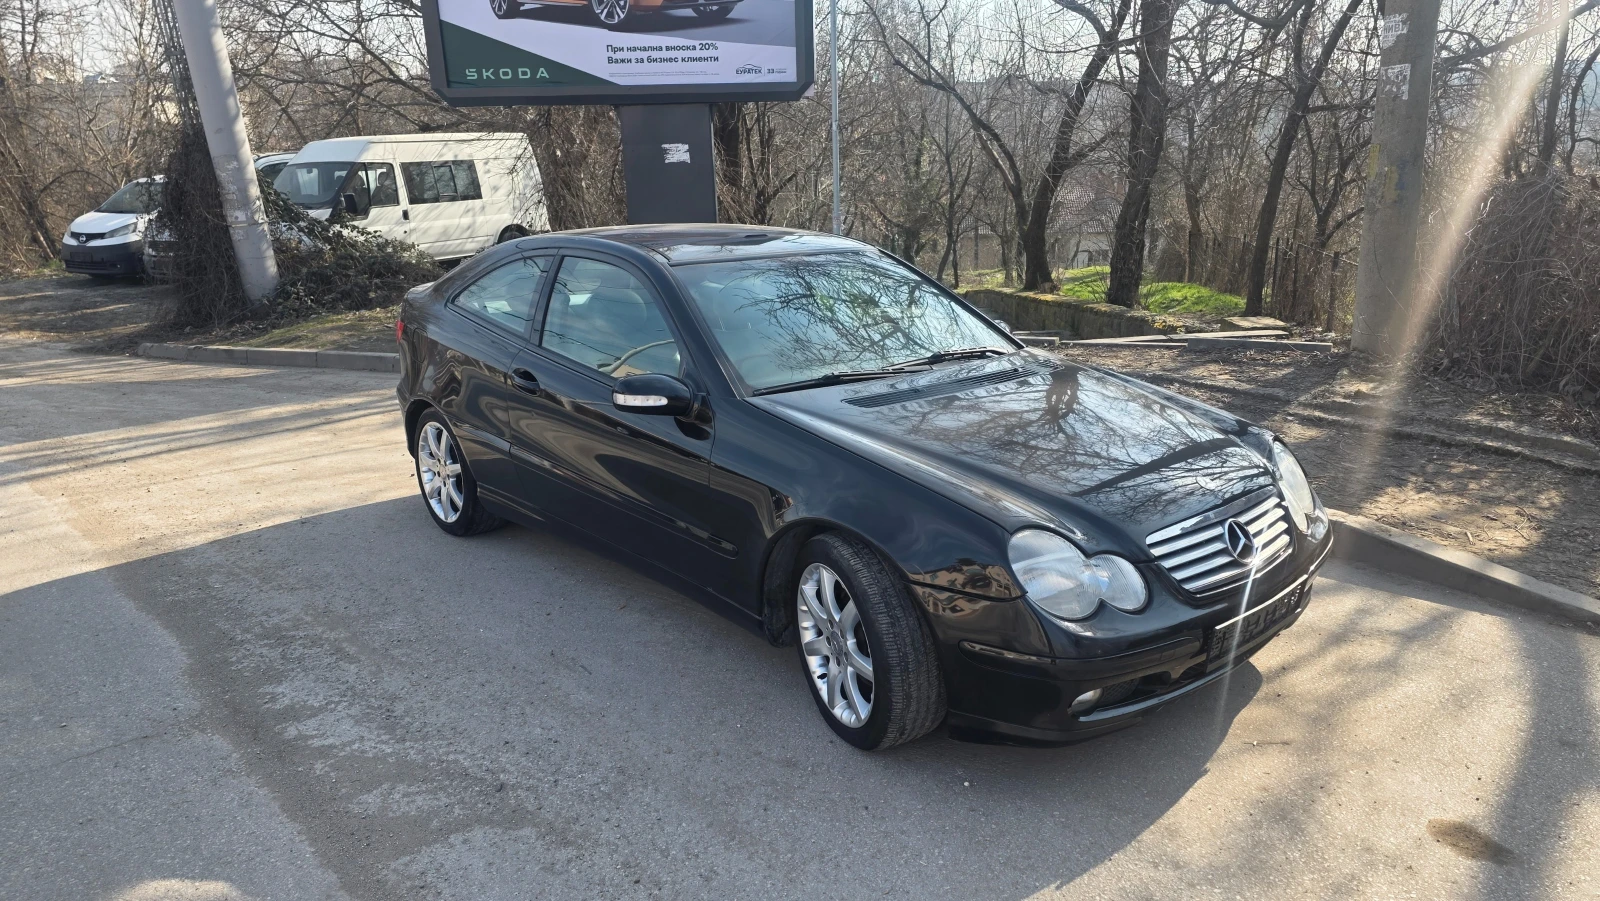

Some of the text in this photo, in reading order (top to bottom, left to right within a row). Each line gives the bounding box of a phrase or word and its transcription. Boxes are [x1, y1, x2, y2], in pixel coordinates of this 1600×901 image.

[606, 42, 719, 54] При начална вноска 20%
[607, 56, 632, 64] Важи
[646, 55, 679, 63] бизнес
[681, 55, 719, 63] клиенти
